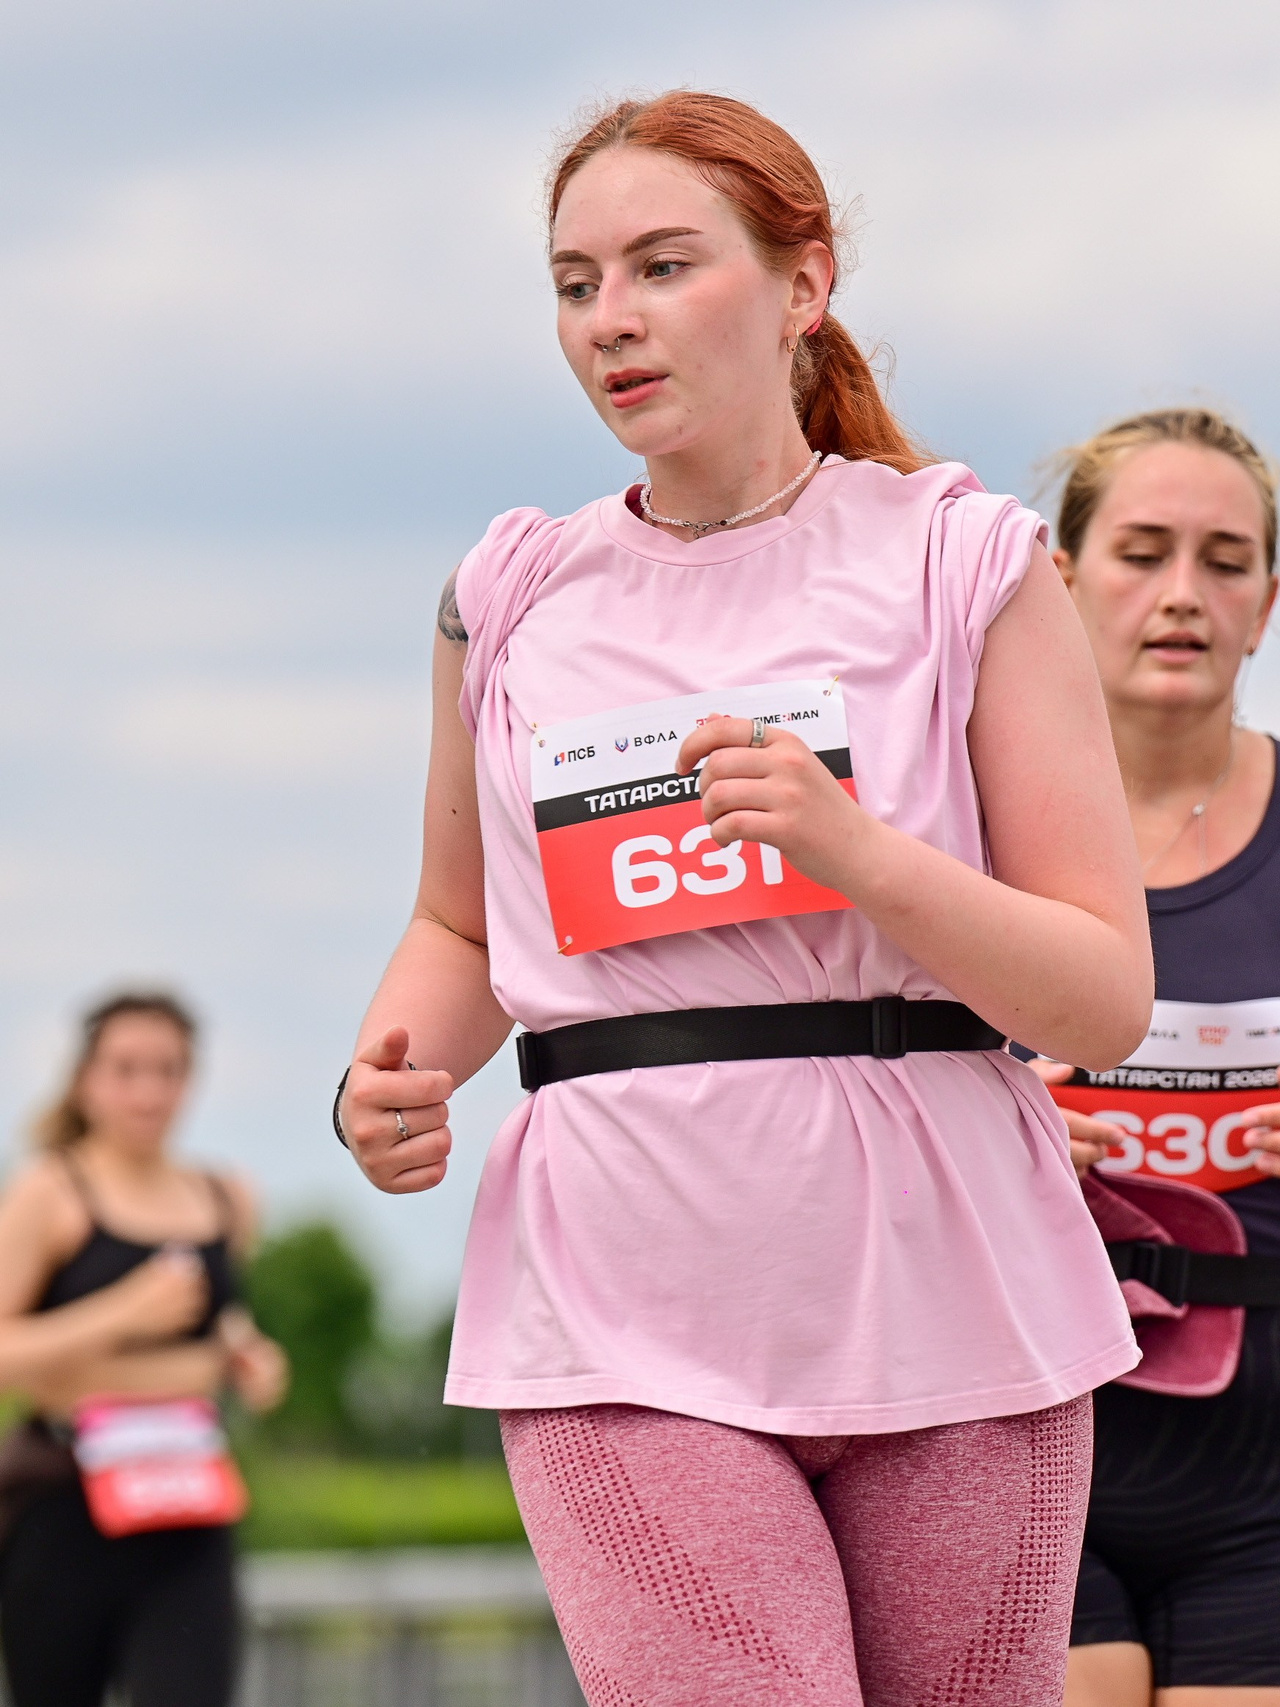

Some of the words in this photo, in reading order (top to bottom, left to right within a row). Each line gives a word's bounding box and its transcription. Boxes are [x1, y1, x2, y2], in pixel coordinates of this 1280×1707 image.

[633, 730, 678, 747] ВФЛА
[567, 745, 596, 763] ПСБ
[584, 776, 701, 813] ТАТАРСТ
[611, 824, 783, 908] 631
